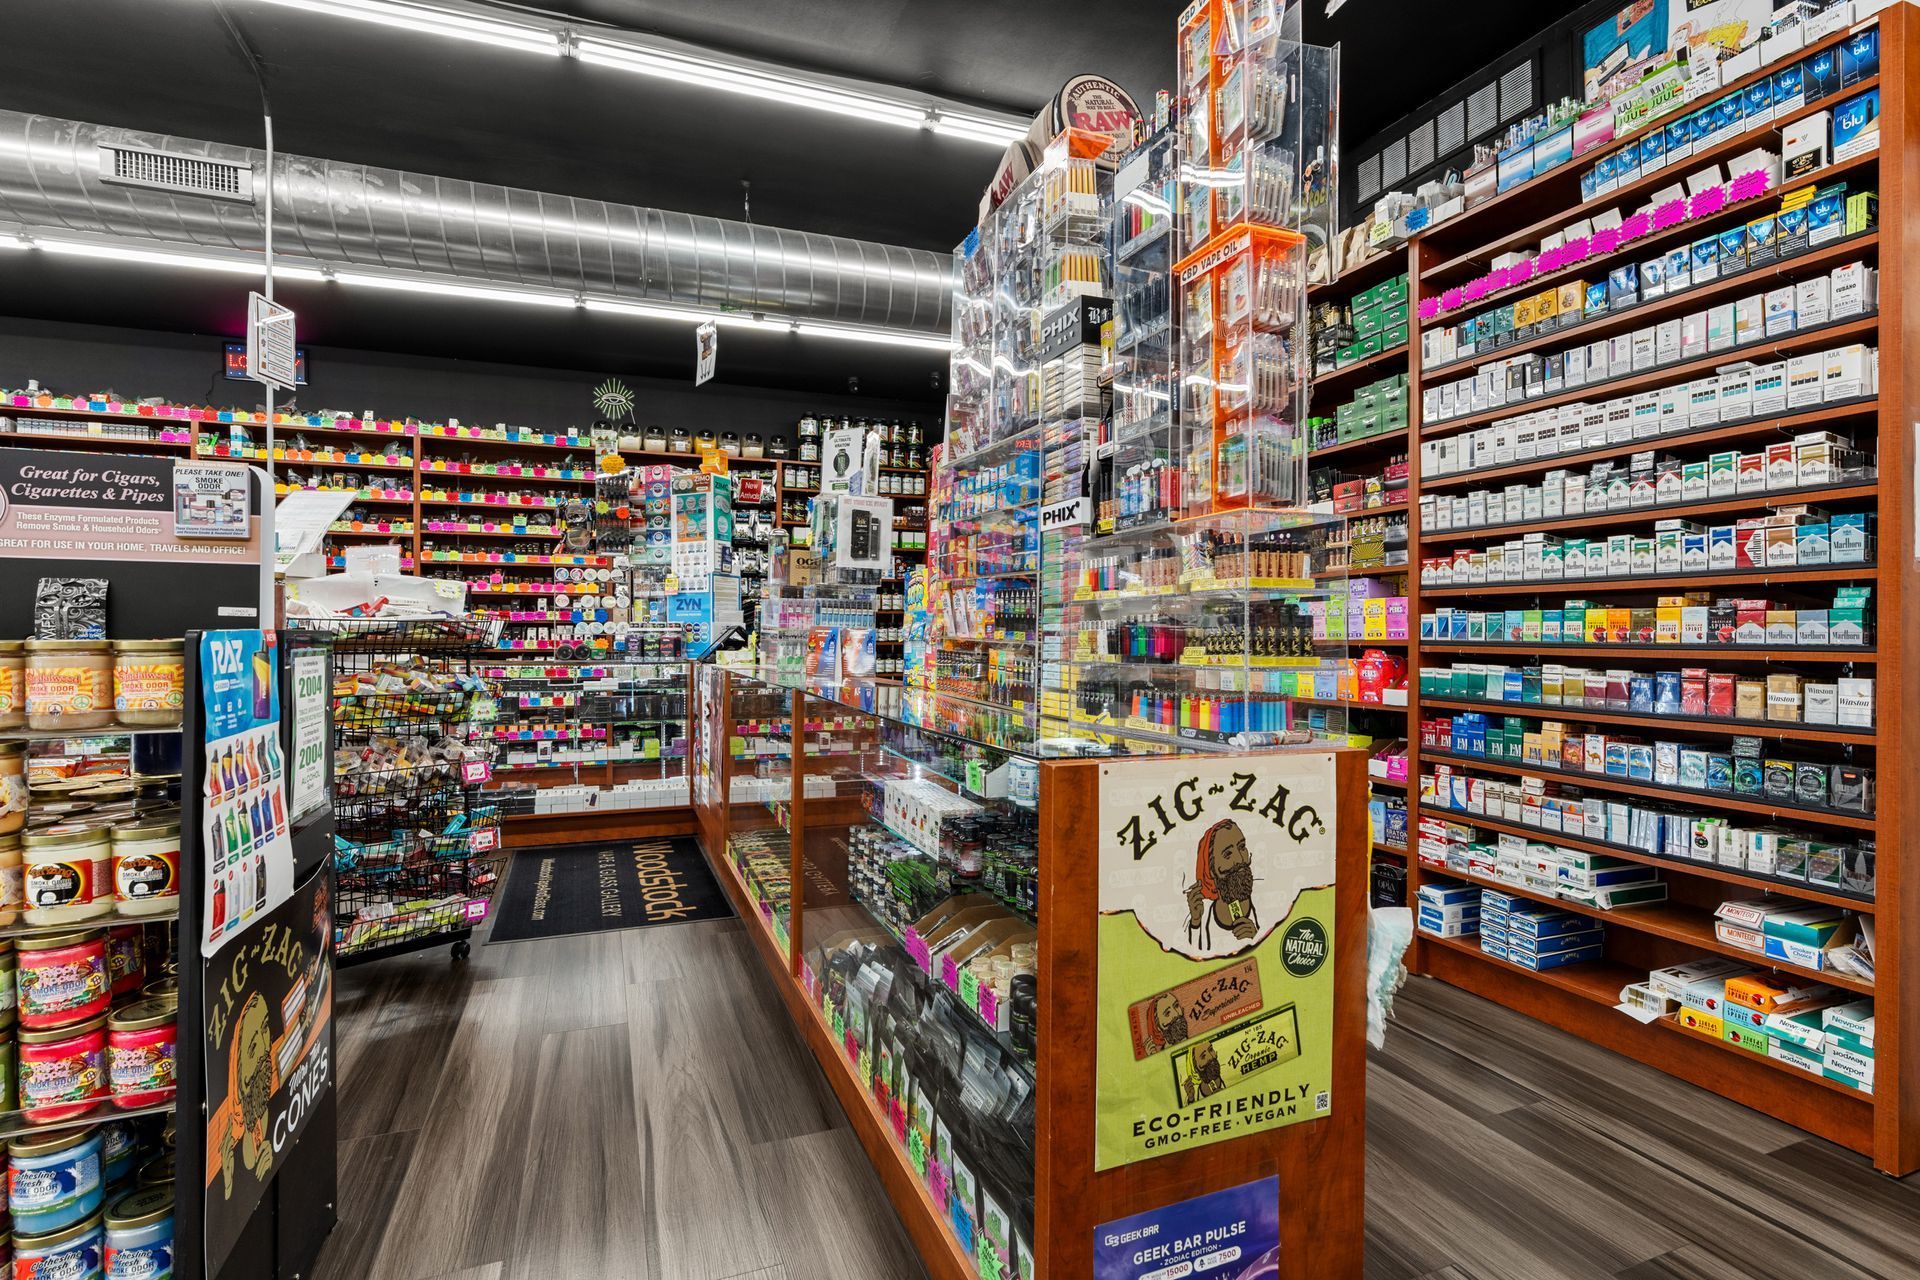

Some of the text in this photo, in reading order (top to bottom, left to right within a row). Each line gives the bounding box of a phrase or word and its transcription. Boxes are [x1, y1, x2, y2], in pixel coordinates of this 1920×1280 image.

[1179, 5, 1196, 27] CBD
[1854, 43, 1869, 55] blu
[1815, 62, 1829, 72] blu
[1781, 76, 1794, 87] blu
[1072, 82, 1120, 100] AUTHENTIC
[1751, 90, 1764, 101] blu
[1072, 111, 1131, 132] RAW
[1837, 112, 1851, 122] my
[1843, 114, 1863, 129] blu
[991, 162, 1018, 207] RAW
[1816, 204, 1830, 214] blu
[1182, 241, 1238, 281] CBD VAPE OIL
[1835, 284, 1857, 293] CUBANO
[1041, 306, 1080, 344] PHIX
[20, 466, 160, 487] Great for Cigars,
[11, 483, 164, 504] Cigarettes & Pipes
[17, 512, 159, 525] These Enzyme Formulated Products
[1042, 502, 1080, 526] PHIX
[17, 522, 50, 530] Remove
[53, 523, 80, 531] Smoke
[92, 525, 133, 533] Household
[0, 539, 246, 555] GREAT FOR USE IN YOUR HOME, TRAVELS AND OFFICE!
[1833, 540, 1861, 549] Marlboro
[1711, 552, 1735, 562] Marlboro
[1769, 552, 1795, 560] Marlboro
[676, 598, 702, 611] ZYN
[1738, 631, 1762, 640] Marlboro
[1768, 630, 1793, 640] Marlboro
[1800, 630, 1826, 640] Marlboro
[1832, 630, 1861, 640] Marlboro
[299, 675, 322, 698] 2004
[1807, 687, 1834, 695] Winston
[1768, 694, 1795, 703] Winston
[1839, 698, 1870, 707] Winston
[1184, 729, 1196, 738] BIC
[299, 741, 323, 770] 2004
[1799, 766, 1823, 775] CAMEL
[1116, 772, 1323, 861] ZIG-ZAG
[598, 850, 615, 862] VAPE
[600, 869, 618, 888] GLASS
[632, 840, 698, 922] Woodstock
[601, 888, 622, 916] GALLERY
[1727, 907, 1755, 919] MONTEGO
[1561, 920, 1584, 928] CAMEL
[1297, 928, 1315, 941] The
[1561, 936, 1580, 945] CAMEL
[1727, 929, 1756, 942] MONTEGO
[1284, 940, 1324, 957] NATURAL
[1789, 945, 1816, 956] Smoker's
[1286, 952, 1316, 967] Choice
[1561, 952, 1580, 962] CAMEL
[1792, 951, 1813, 960] Choice
[32, 986, 60, 994] SMOKE
[208, 922, 303, 1050] ZIG-ZAG
[1188, 976, 1253, 1021] ZIG-ZAG
[1686, 995, 1704, 1006] SPIRIT
[1728, 990, 1748, 1001] SPIRIT
[1223, 1001, 1261, 1021] UNBLEACHED
[1727, 1010, 1748, 1022] SPIRIT
[1252, 1024, 1262, 1033] 185
[1831, 1015, 1866, 1032] Newport
[1228, 1029, 1289, 1069] ZIG-ZAG
[1245, 1046, 1271, 1062] Organic
[1241, 1052, 1276, 1075] HEMP
[1780, 1053, 1811, 1071] Newport
[1833, 1050, 1867, 1067] Newport
[1831, 1059, 1865, 1078] Newport
[273, 1046, 328, 1153] CONES
[1132, 1083, 1311, 1139] ECO-FRIENDLY
[1144, 1104, 1297, 1150] GMO-FREE VEGAN
[34, 1183, 58, 1193] ODOR
[1120, 1224, 1159, 1244] GEEK BAR
[1133, 1221, 1246, 1265] GEEK BAR PULSE
[31, 1251, 82, 1271] Clothesline
[109, 1251, 152, 1262] Clothesline
[1164, 1252, 1190, 1266] ZODIAC
[1191, 1244, 1218, 1258] EDITION
[59, 1262, 84, 1277] ODOR
[131, 1262, 156, 1273] ODOR
[1166, 1265, 1189, 1277] 15000
[1218, 1249, 1237, 1262] 7500
